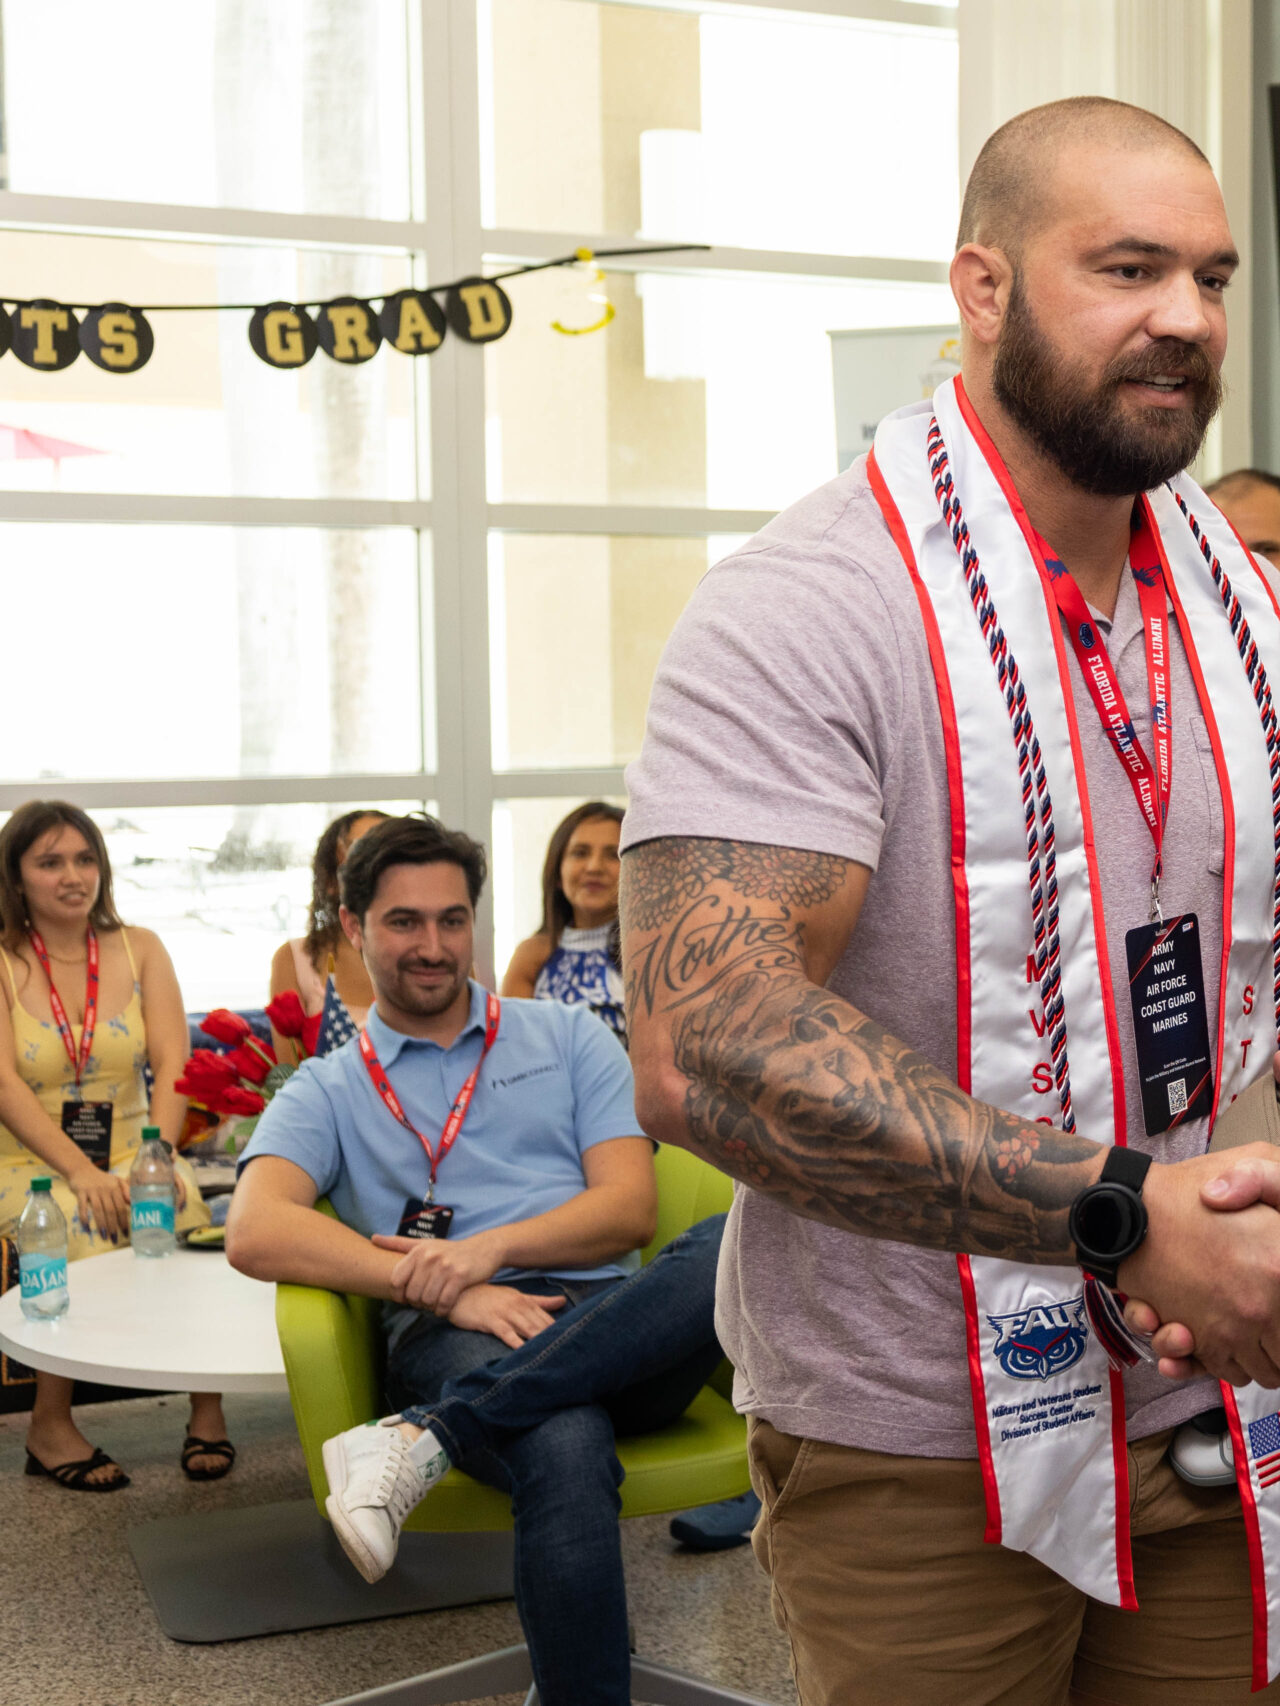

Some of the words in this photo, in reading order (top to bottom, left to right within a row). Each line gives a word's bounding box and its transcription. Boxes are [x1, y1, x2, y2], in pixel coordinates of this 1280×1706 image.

[263, 283, 507, 364] GRAD
[1150, 617, 1164, 667] ALUMNI
[1156, 671, 1168, 734] ATLANTIC
[1087, 653, 1117, 711] FLORIDA
[1108, 712, 1144, 773] ATLANTIC
[1137, 776, 1158, 828] ALUMNI
[1151, 940, 1175, 957] ARMY
[1153, 958, 1175, 975] NAVY
[1146, 983, 1161, 997] AIR
[1161, 974, 1188, 993] FORCE
[1141, 999, 1167, 1018] COAST
[1167, 991, 1196, 1009] GUARD
[1152, 1012, 1189, 1034] MARINES
[996, 1304, 1082, 1347] FAU
[992, 1403, 1021, 1419] Military
[1021, 1399, 1037, 1412] and
[1038, 1392, 1072, 1407] Veterans
[1072, 1384, 1102, 1399] Student
[1019, 1410, 1048, 1425] Success
[1050, 1403, 1075, 1416] Center
[1001, 1426, 1032, 1442] Division
[1032, 1423, 1041, 1433] of
[1042, 1416, 1070, 1431] Student
[1070, 1408, 1096, 1424] Affairs
